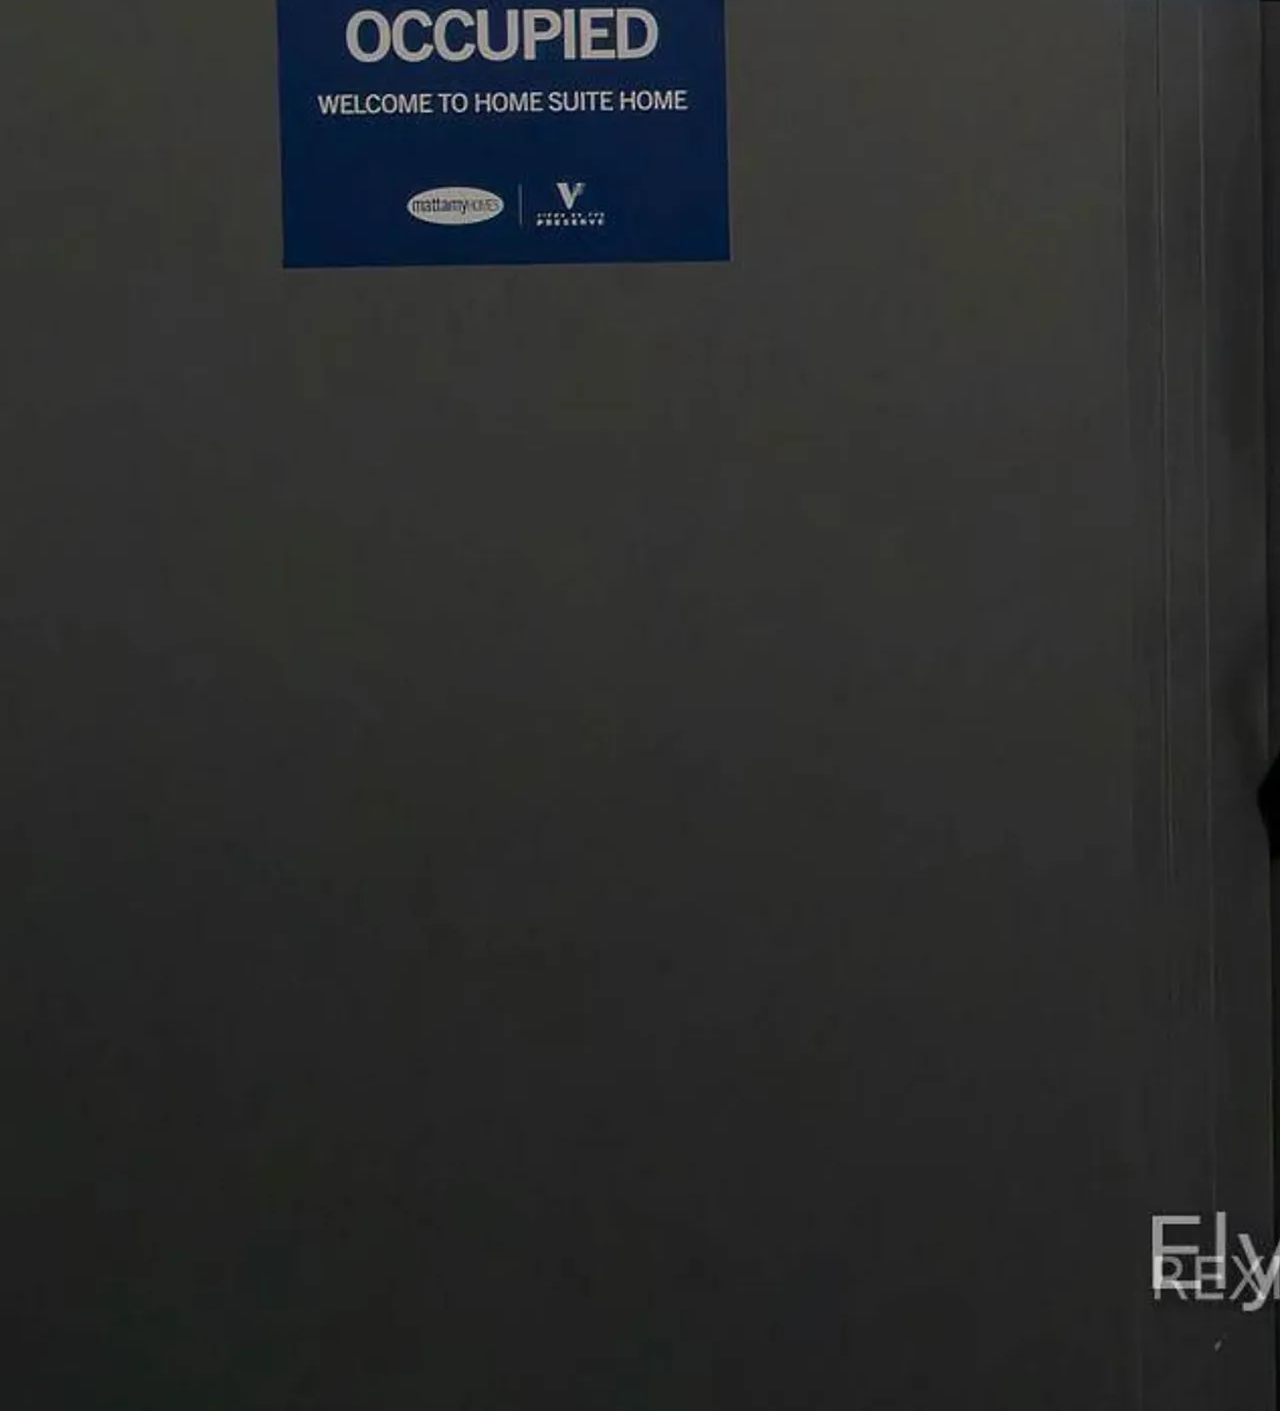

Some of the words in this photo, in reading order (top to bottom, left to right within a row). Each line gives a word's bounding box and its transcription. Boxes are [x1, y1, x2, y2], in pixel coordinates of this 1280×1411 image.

[345, 7, 660, 63] OCCUPIED
[317, 93, 434, 115] WELCOME
[438, 93, 468, 114] TO
[474, 92, 544, 113] HOME
[548, 91, 614, 113] SUITE
[619, 90, 689, 112] HOME
